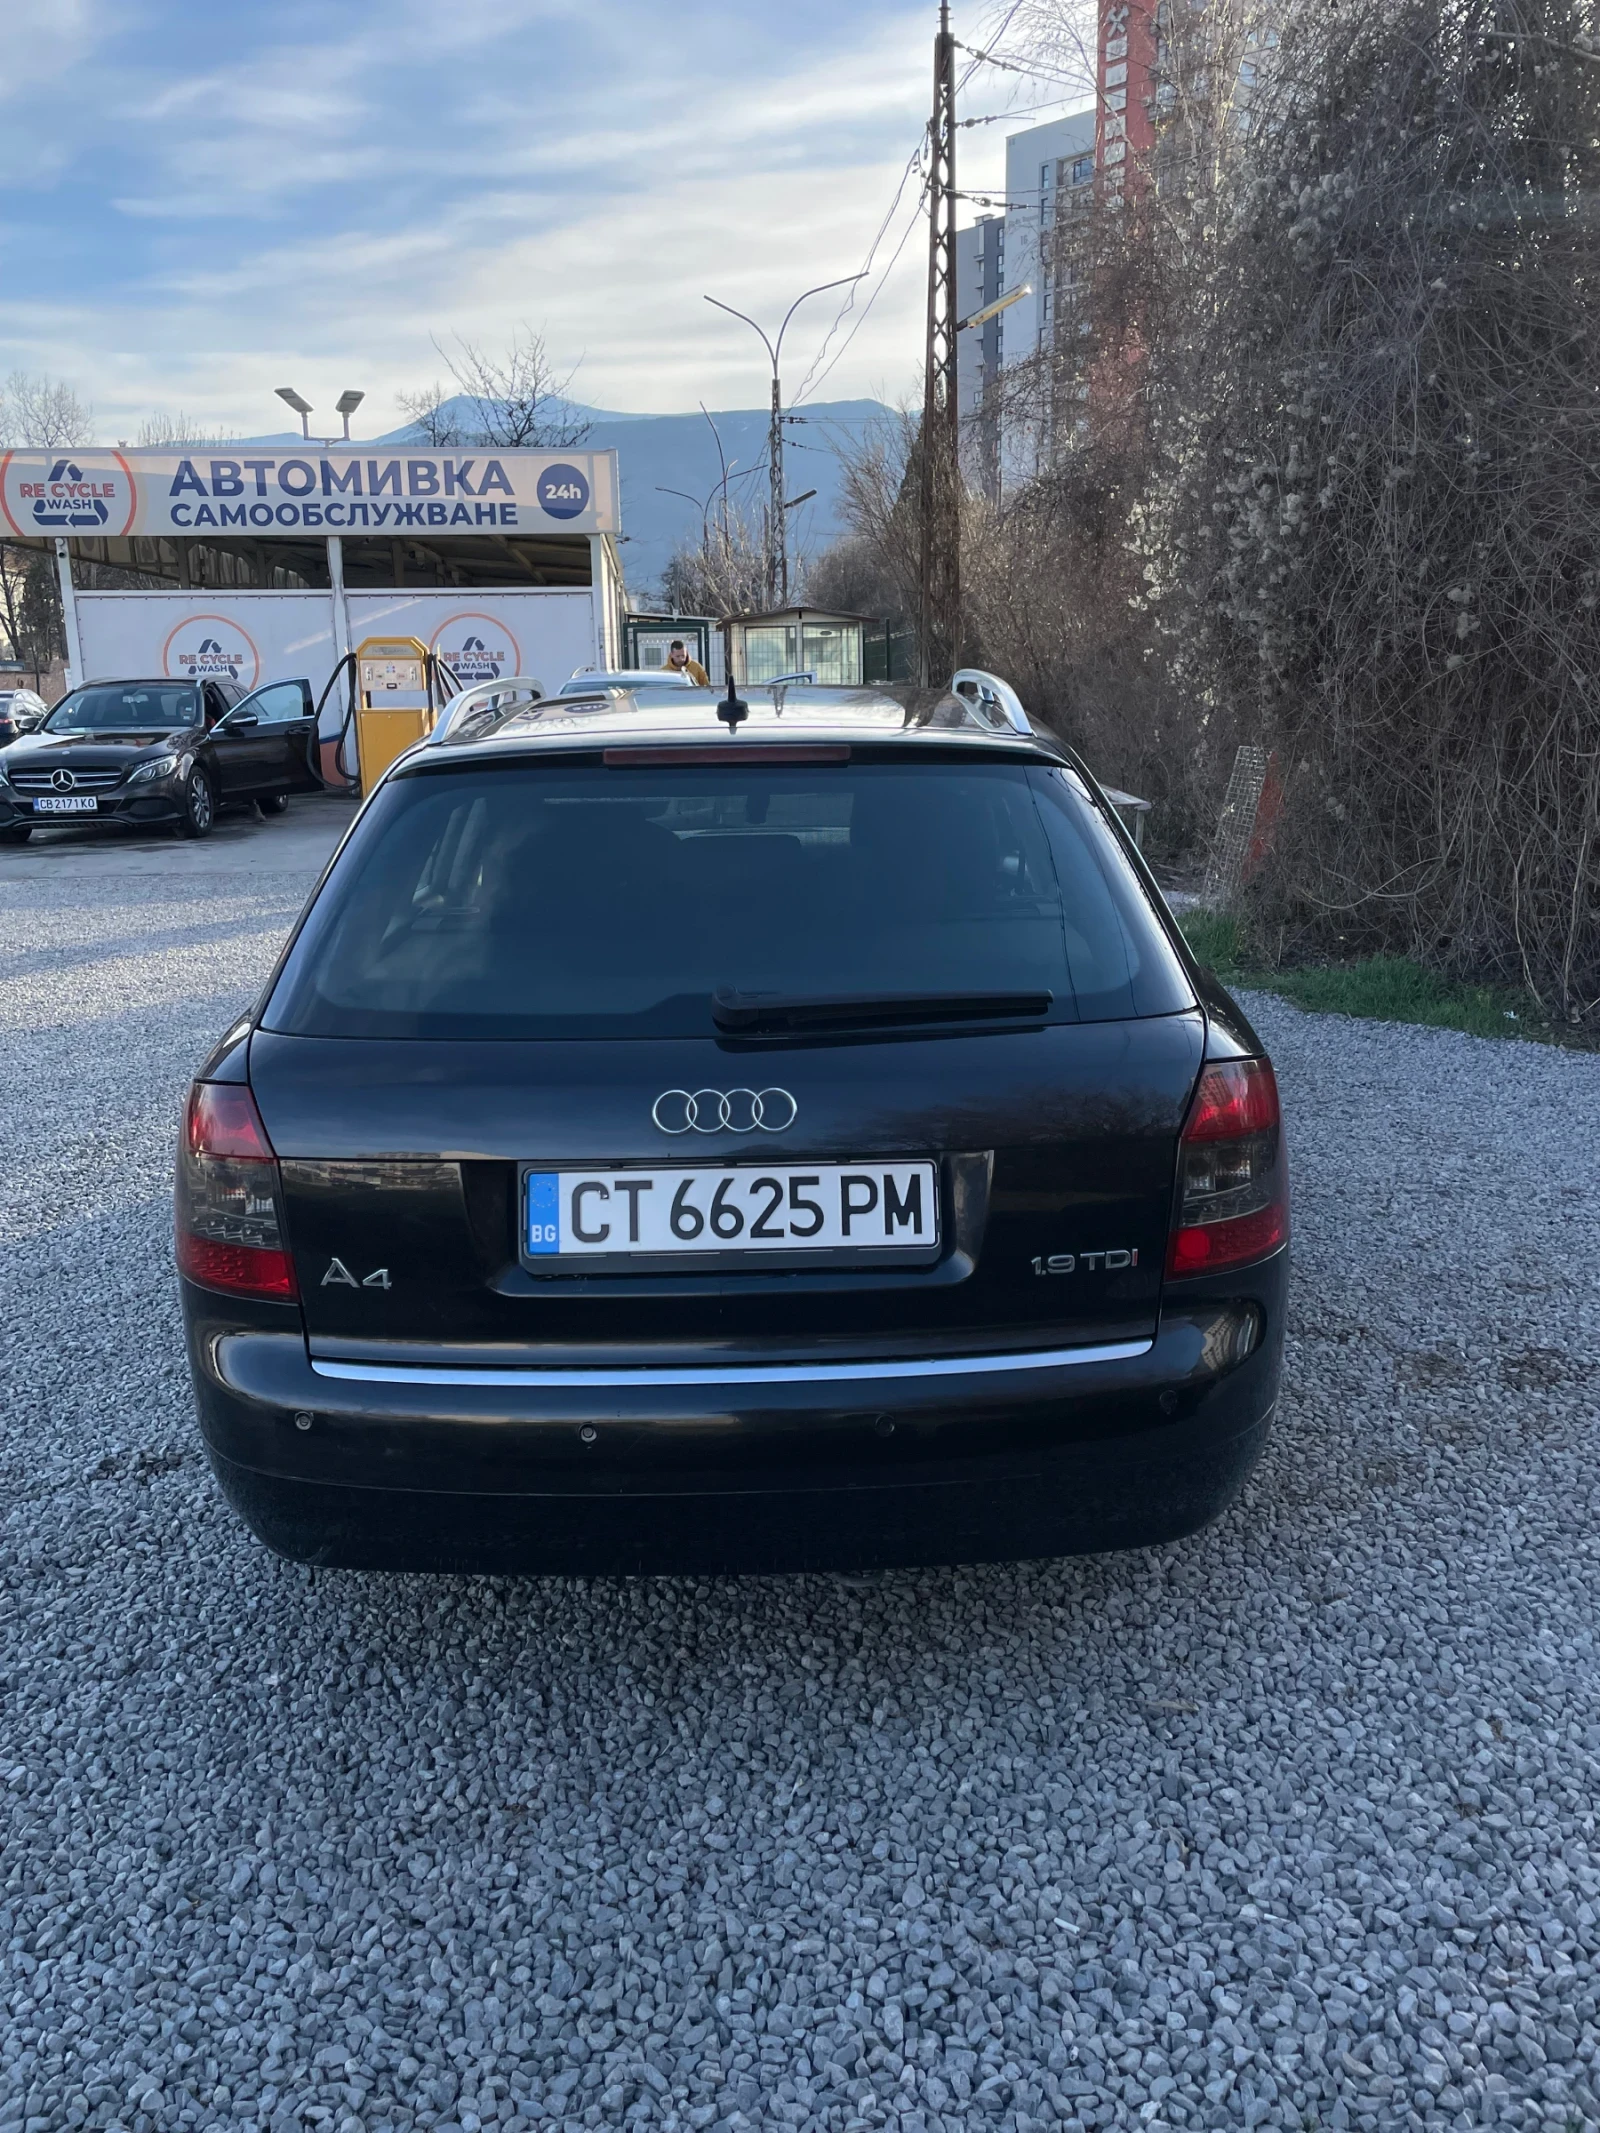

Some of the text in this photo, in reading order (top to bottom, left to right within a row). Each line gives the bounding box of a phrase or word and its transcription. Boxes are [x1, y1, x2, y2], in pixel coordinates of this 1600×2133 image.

[169, 460, 515, 497] АВТОМИВКА
[20, 483, 115, 498] RE CYCLE
[545, 483, 582, 499] 24h
[46, 499, 92, 510] WASH
[170, 503, 518, 527] САМООБСЛУЖВАНЕ
[179, 654, 243, 665] RE CYCLE
[443, 651, 505, 662] RE CYCLE
[460, 662, 490, 670] WASH
[40, 799, 53, 809] CB
[55, 798, 79, 809] 2171
[80, 798, 95, 808] KO
[571, 1174, 923, 1243] CT 6625 PM
[531, 1224, 556, 1243] BG
[320, 1257, 392, 1290] A4
